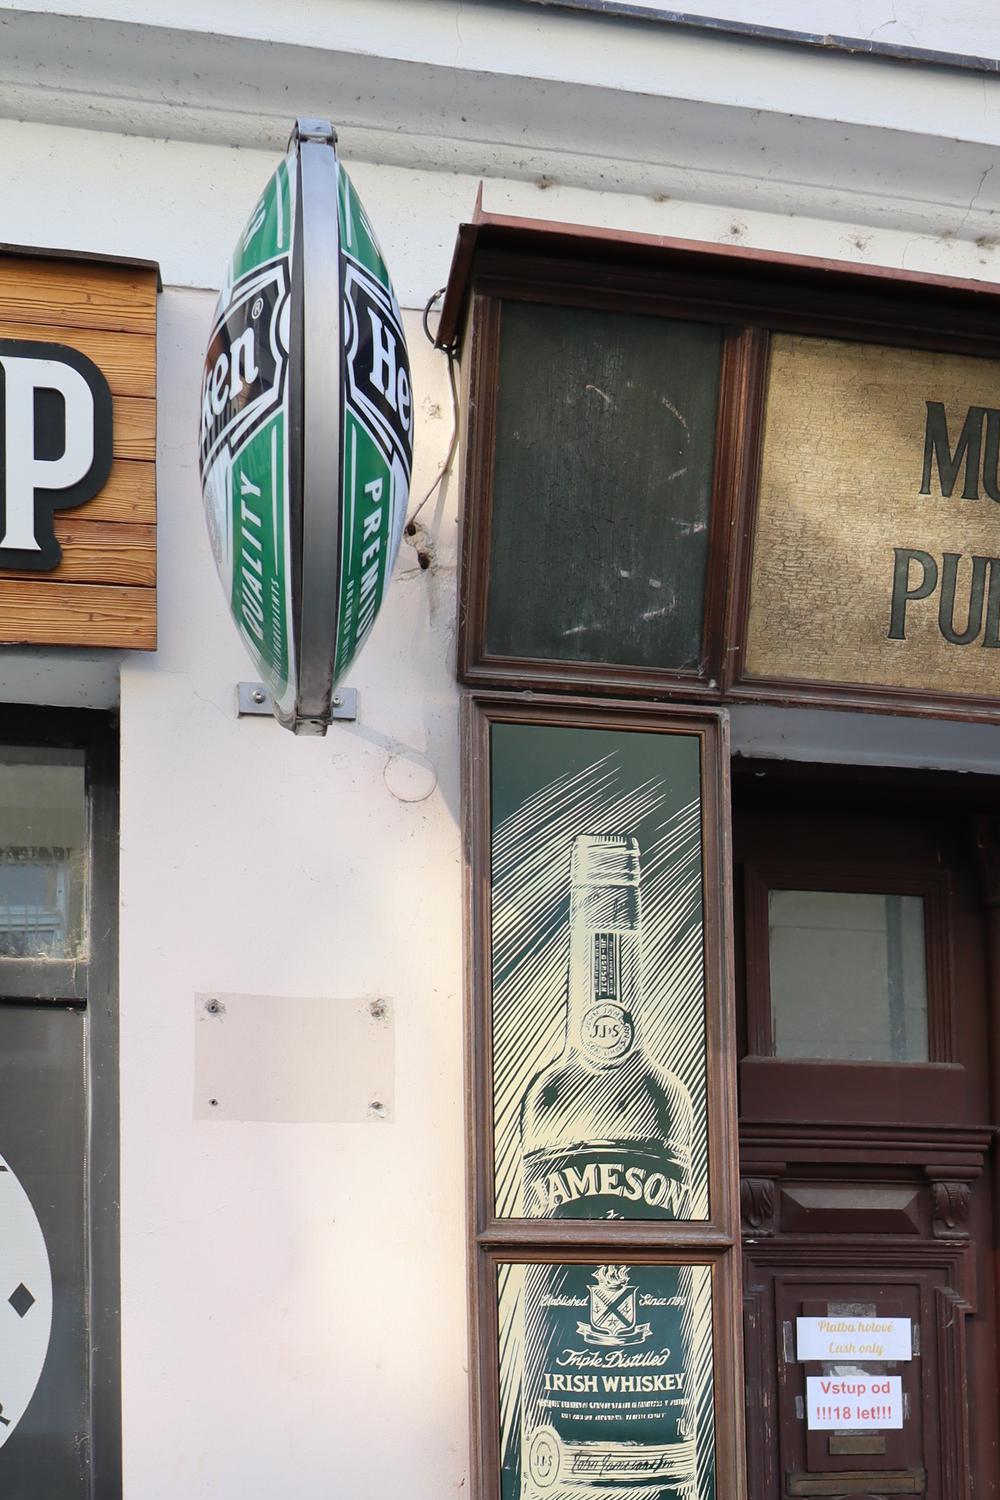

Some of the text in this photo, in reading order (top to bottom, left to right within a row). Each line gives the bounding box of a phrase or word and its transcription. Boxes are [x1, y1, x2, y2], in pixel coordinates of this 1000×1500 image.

[368, 306, 413, 448] He
[240, 470, 264, 640] QUALITY
[531, 1163, 690, 1215] JAMESON
[817, 1321, 855, 1333] Platba
[829, 1341, 884, 1356] Cash only
[556, 1348, 604, 1370] Triple
[544, 1373, 685, 1392] IRISH WHISKEY
[820, 1381, 891, 1397] Vstup od
[816, 1406, 892, 1420] !!!18 let!!!
